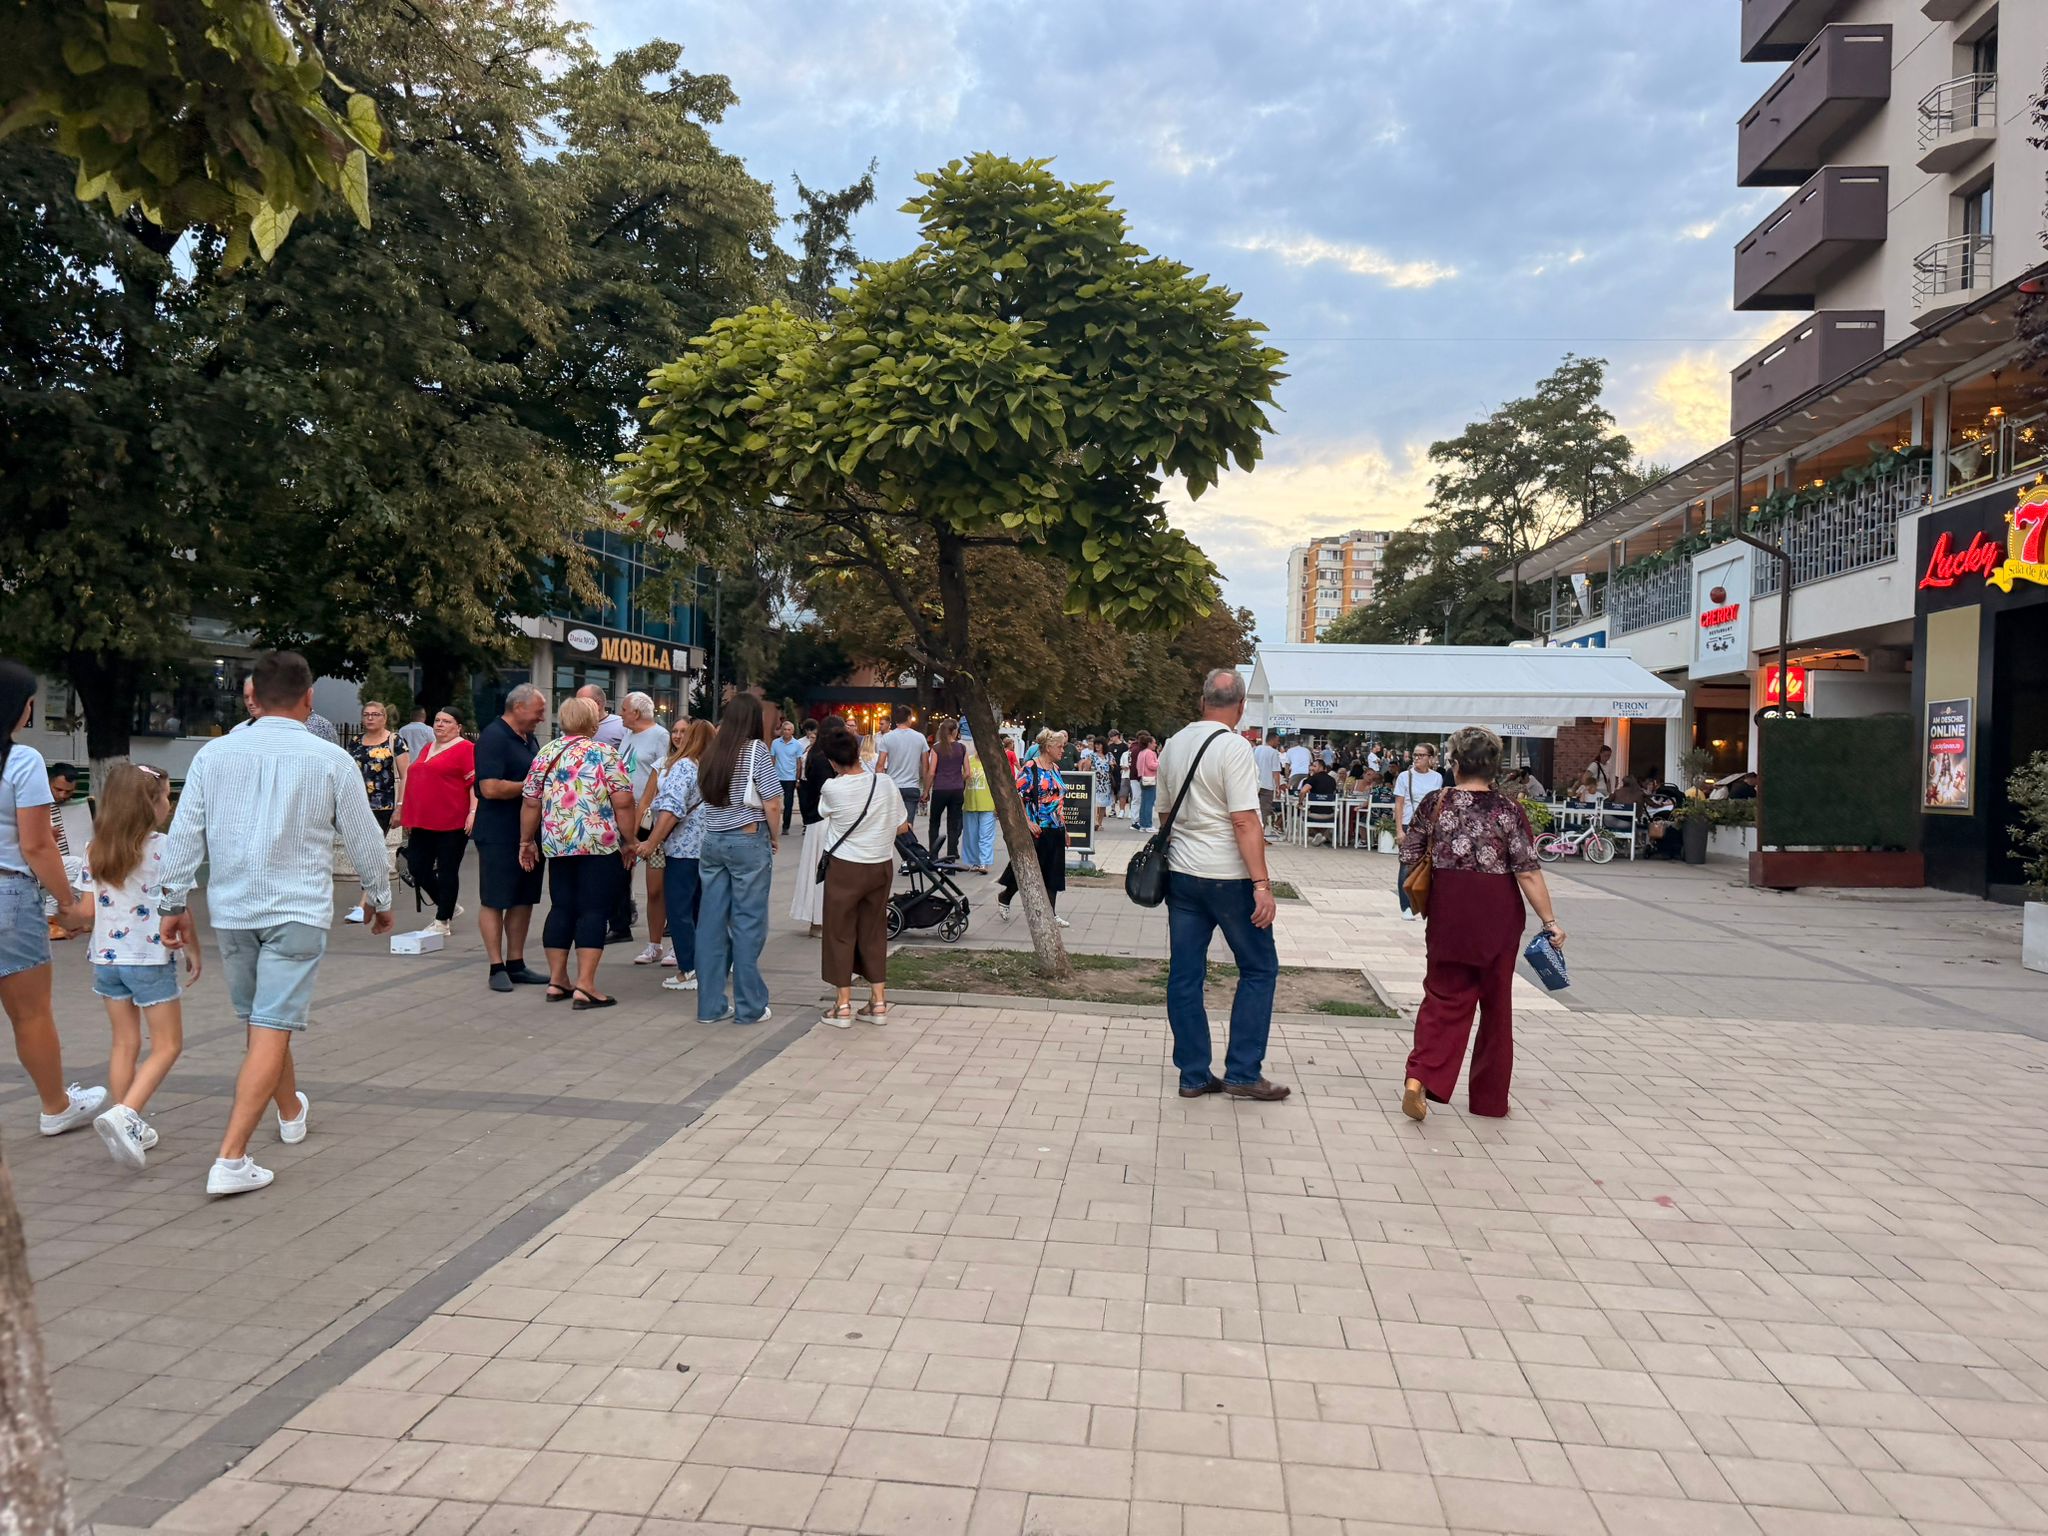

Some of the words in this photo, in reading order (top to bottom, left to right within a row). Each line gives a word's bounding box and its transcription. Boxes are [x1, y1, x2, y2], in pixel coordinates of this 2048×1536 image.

[1919, 531, 1999, 589] Lucky
[2014, 499, 2048, 565] 7
[2026, 565, 2036, 577] de
[1701, 604, 1740, 628] CHERRY
[601, 637, 671, 671] MOBILA
[1304, 698, 1338, 708] PERONI
[1612, 701, 1648, 710] PERONI
[1932, 716, 1940, 724] AM
[1941, 715, 1964, 724] DESCHIS
[1930, 723, 1966, 738] ONLINE
